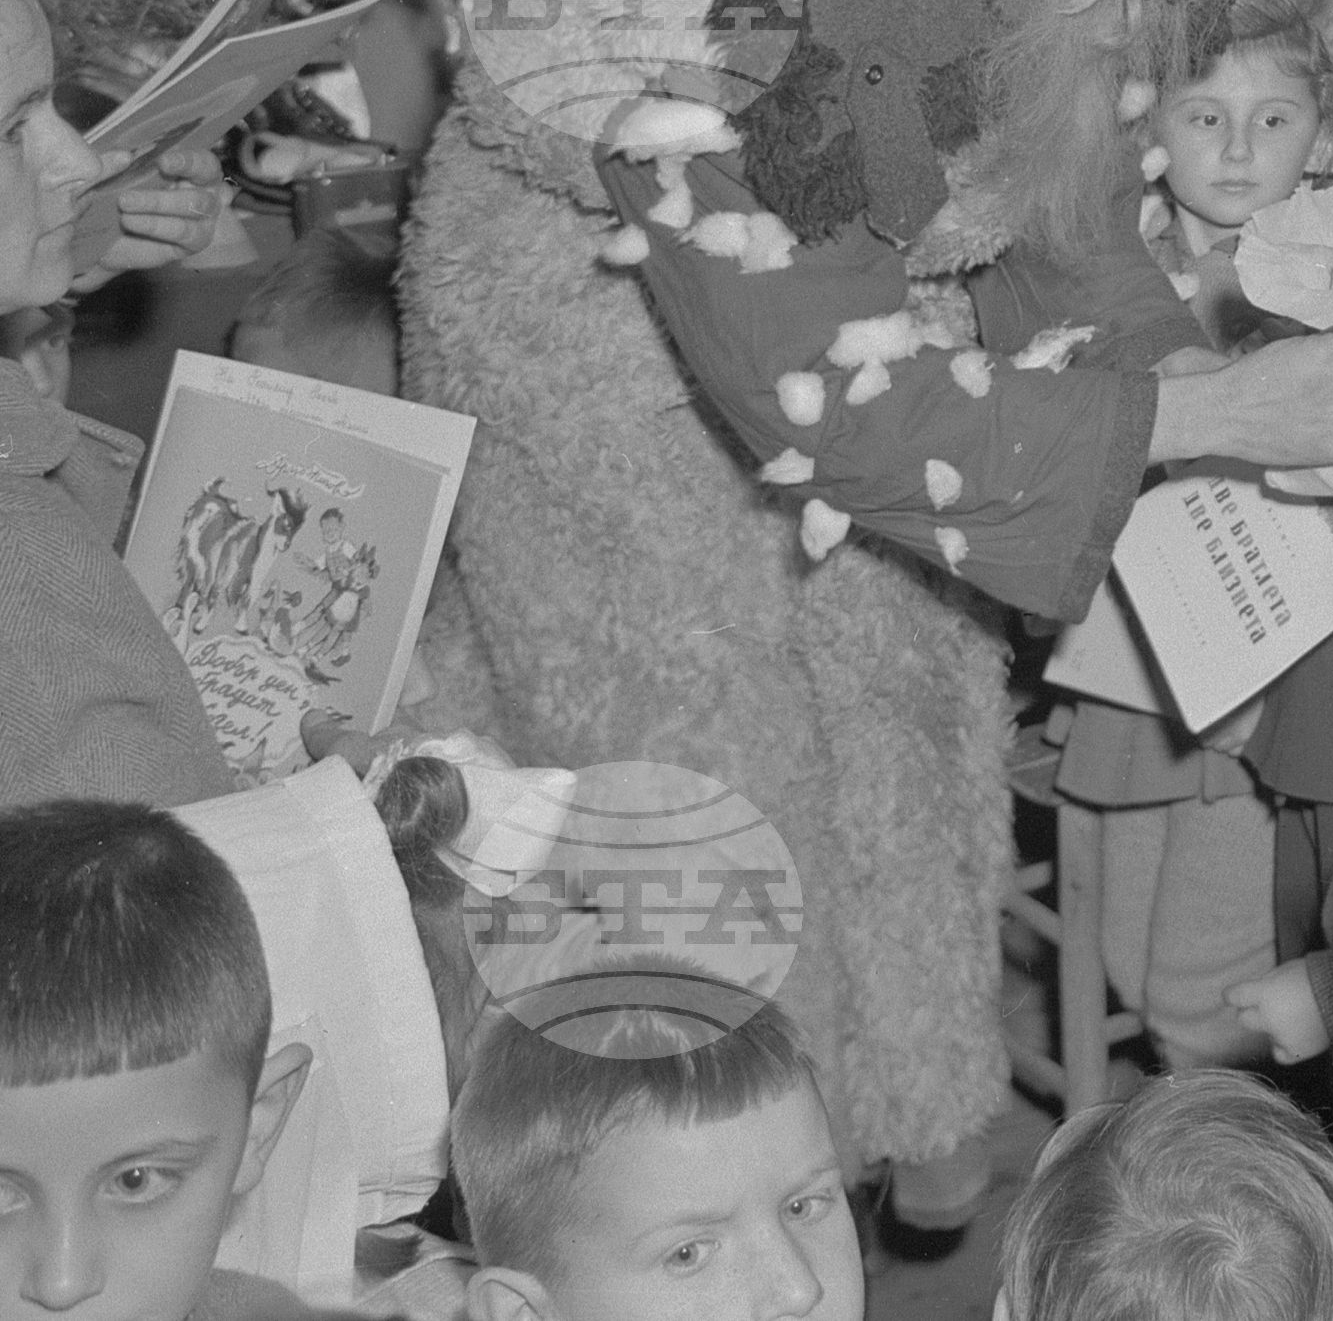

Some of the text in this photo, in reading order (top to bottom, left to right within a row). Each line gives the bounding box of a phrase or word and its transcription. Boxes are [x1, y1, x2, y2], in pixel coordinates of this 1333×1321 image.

[1183, 490, 1266, 645] две близнета
[1230, 519, 1292, 627] братлета
[189, 640, 260, 684] Добър
